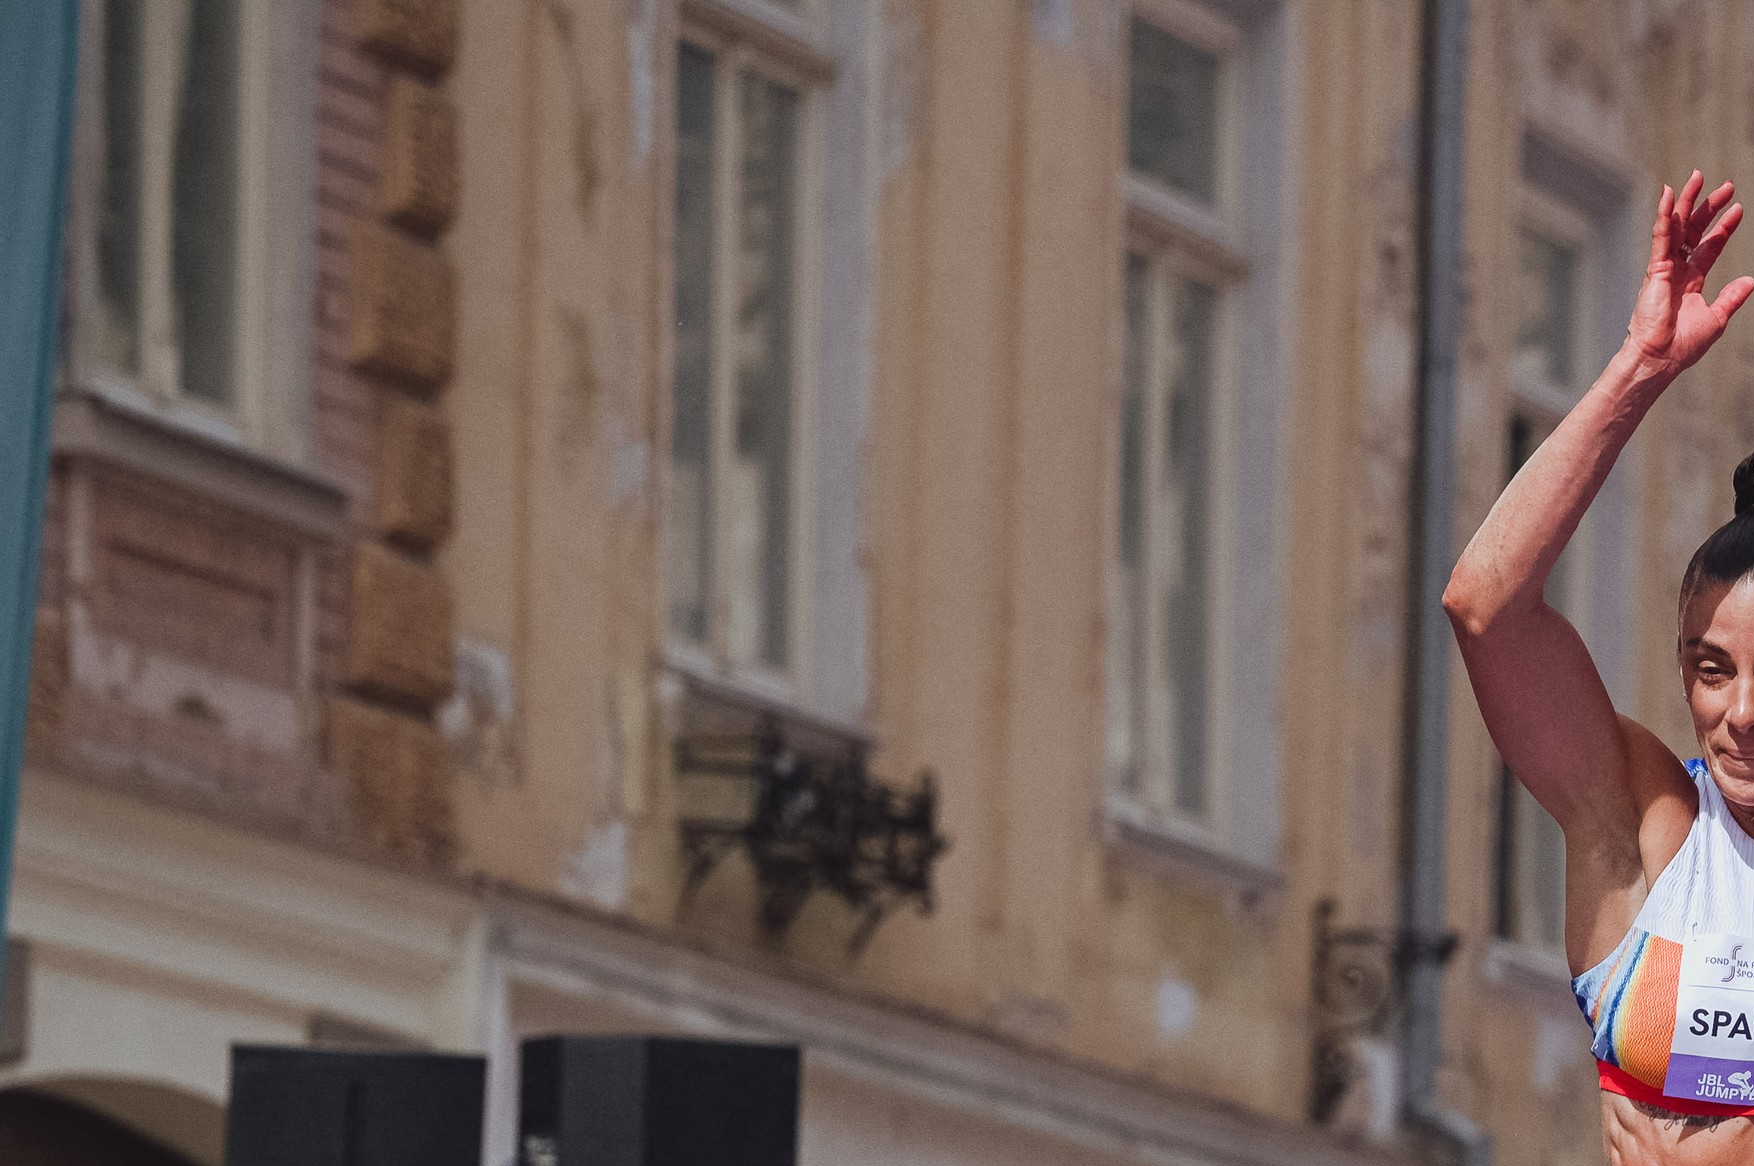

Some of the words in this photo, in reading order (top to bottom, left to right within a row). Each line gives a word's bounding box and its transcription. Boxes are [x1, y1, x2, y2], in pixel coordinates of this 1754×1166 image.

[1705, 956, 1729, 966] FOND
[1737, 959, 1749, 969] NA
[1697, 1073, 1725, 1088] JBL
